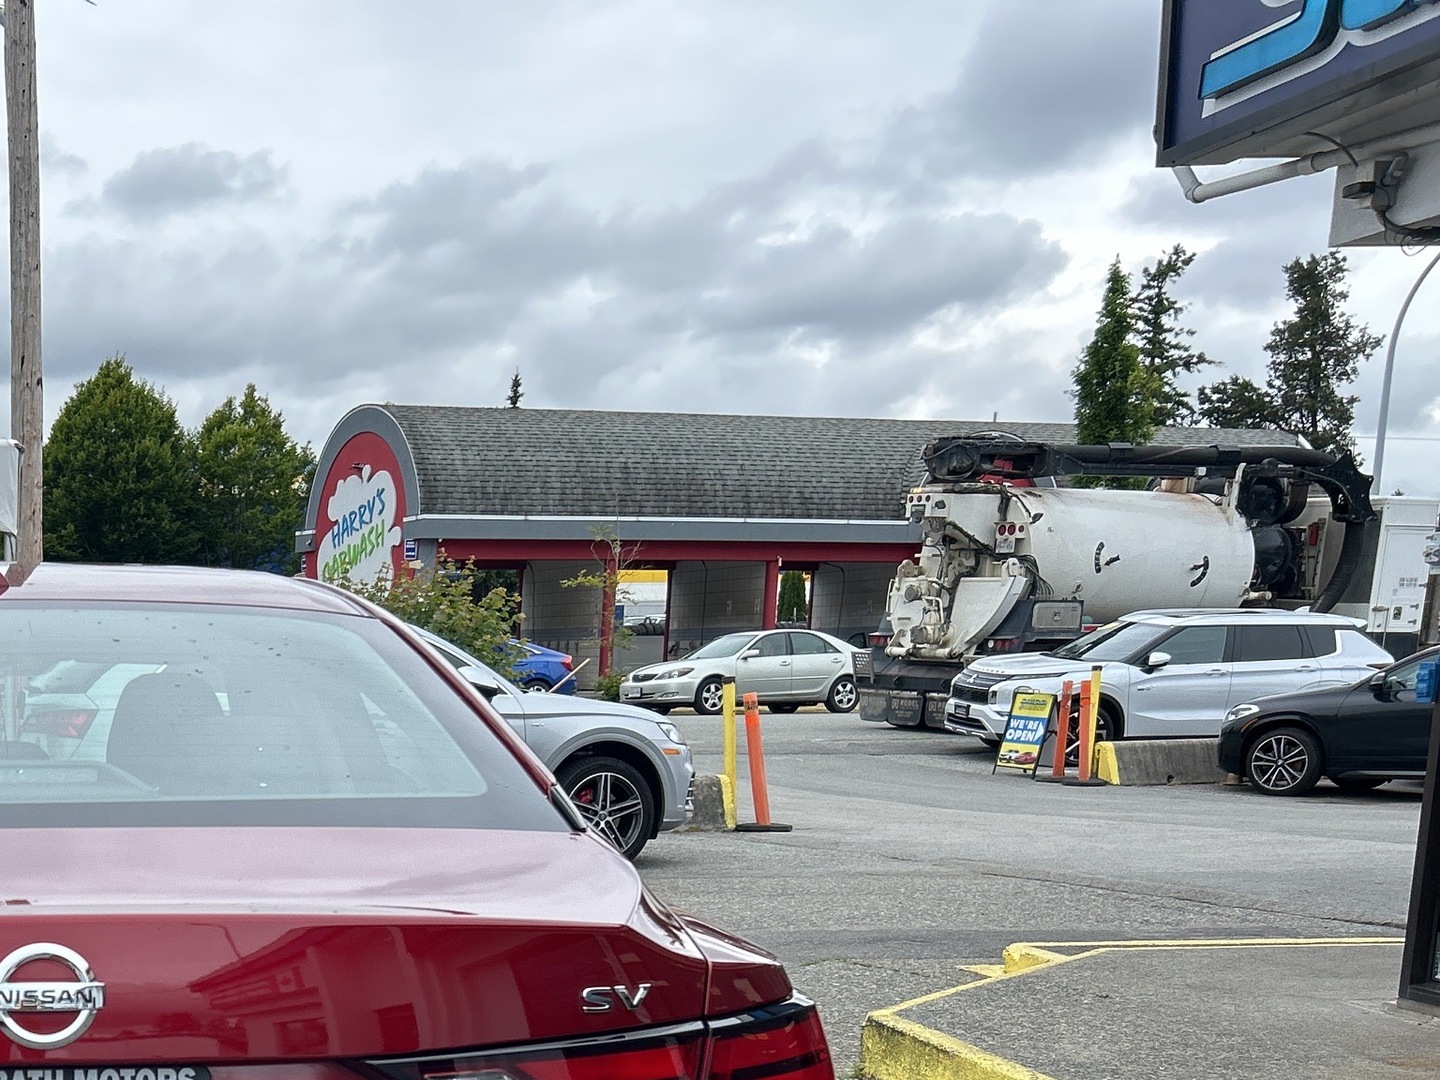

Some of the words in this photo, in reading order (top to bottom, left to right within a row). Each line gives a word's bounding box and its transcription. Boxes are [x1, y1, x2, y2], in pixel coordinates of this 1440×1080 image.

[331, 488, 385, 549] HARRY'S
[322, 519, 385, 578] CARWASH
[1005, 729, 1036, 741] OPEN
[582, 983, 652, 1013] SV
